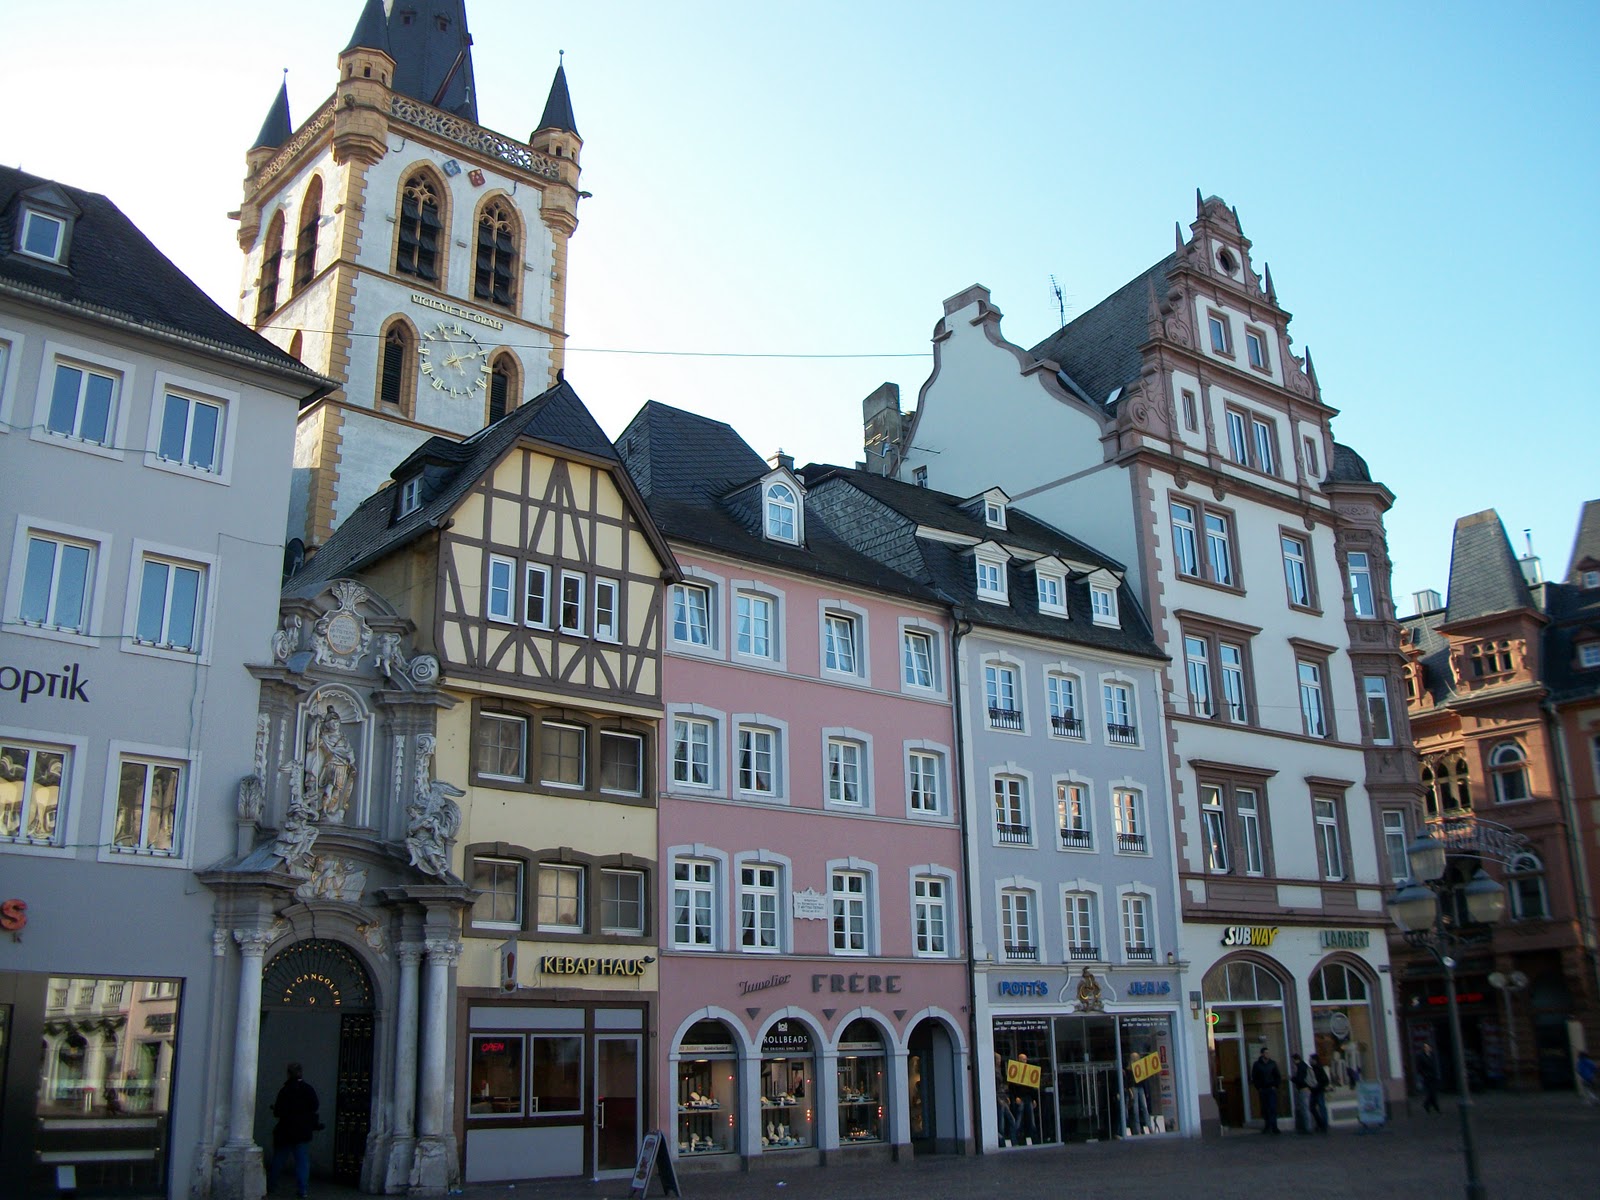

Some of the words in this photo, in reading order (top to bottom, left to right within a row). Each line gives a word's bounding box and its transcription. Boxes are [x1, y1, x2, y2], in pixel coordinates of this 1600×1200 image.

[411, 295, 454, 314] VIGILATE
[459, 309, 470, 319] ET
[473, 314, 503, 331] ORATE
[1222, 926, 1280, 947] SUBWAY
[1322, 930, 1370, 948] LAMBERT
[542, 955, 597, 975] KEBAP
[600, 959, 646, 977] HAUS
[296, 973, 341, 1005] GANGOLPH
[739, 974, 791, 996] Juwelier
[1001, 980, 1049, 996] POTT'S
[309, 996, 316, 1005] 9
[481, 1042, 505, 1053] OPEN
